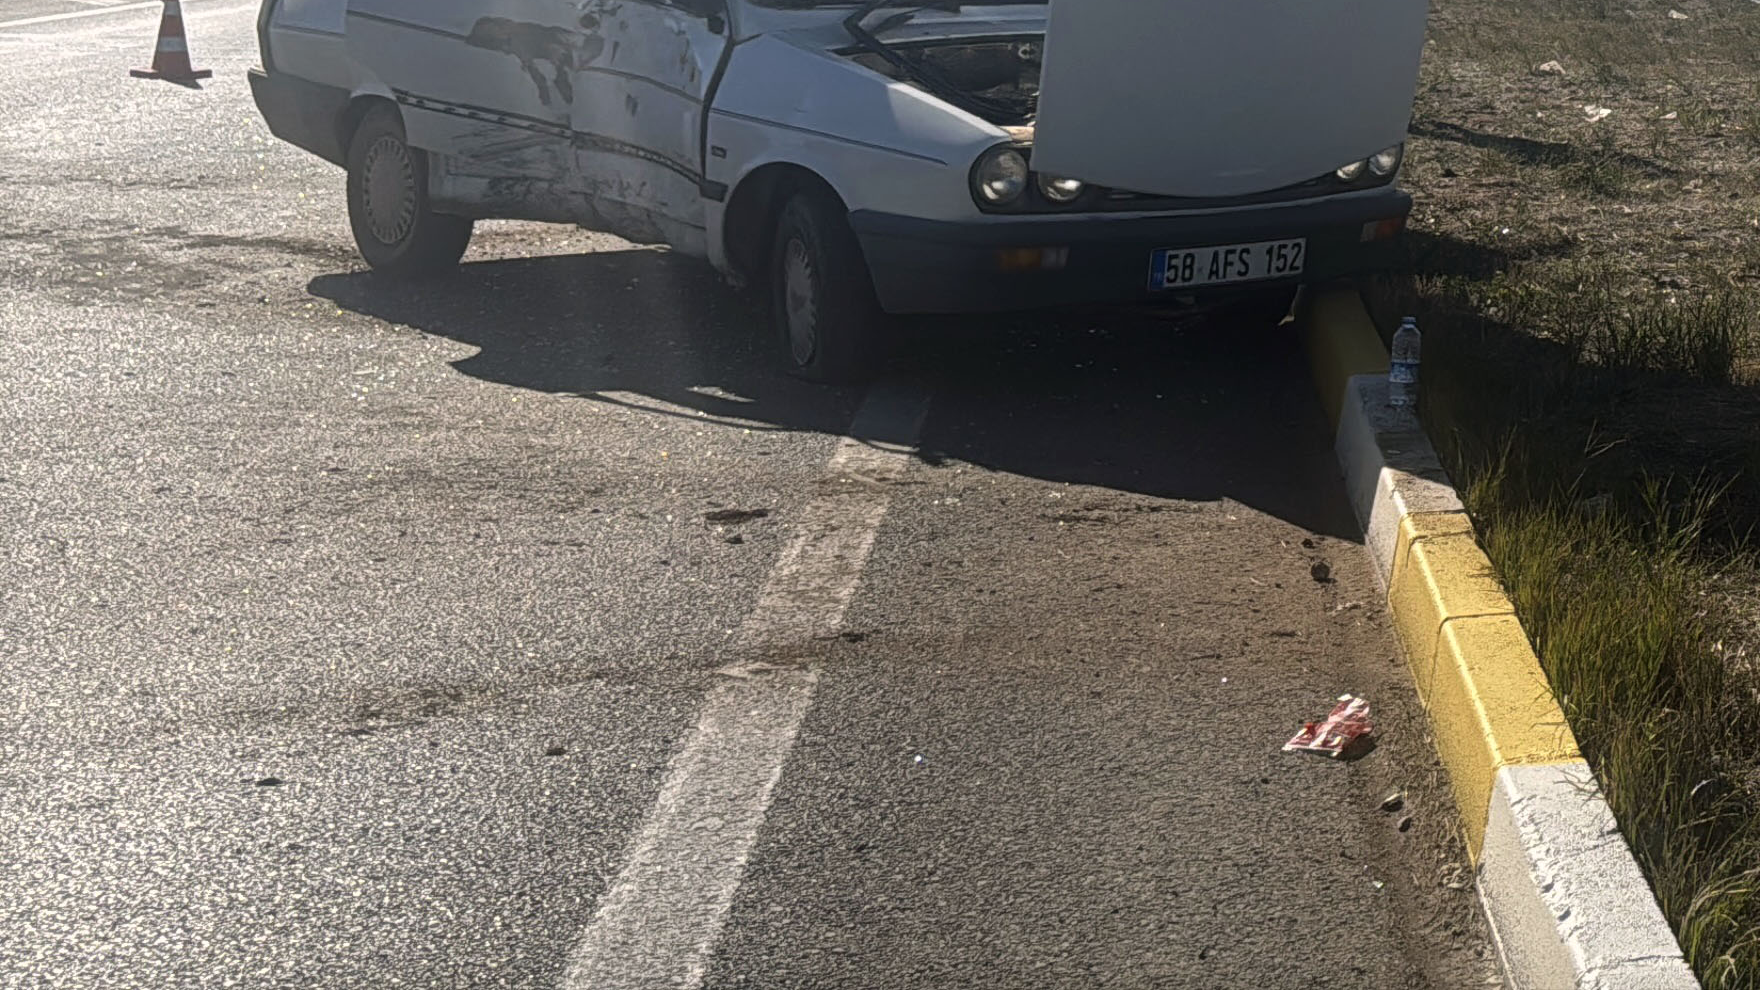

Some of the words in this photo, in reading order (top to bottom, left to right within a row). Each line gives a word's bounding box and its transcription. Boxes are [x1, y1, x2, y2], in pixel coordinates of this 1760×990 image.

[1165, 252, 1196, 284] 58
[1207, 248, 1252, 281] AFS
[1265, 242, 1302, 275] 152
